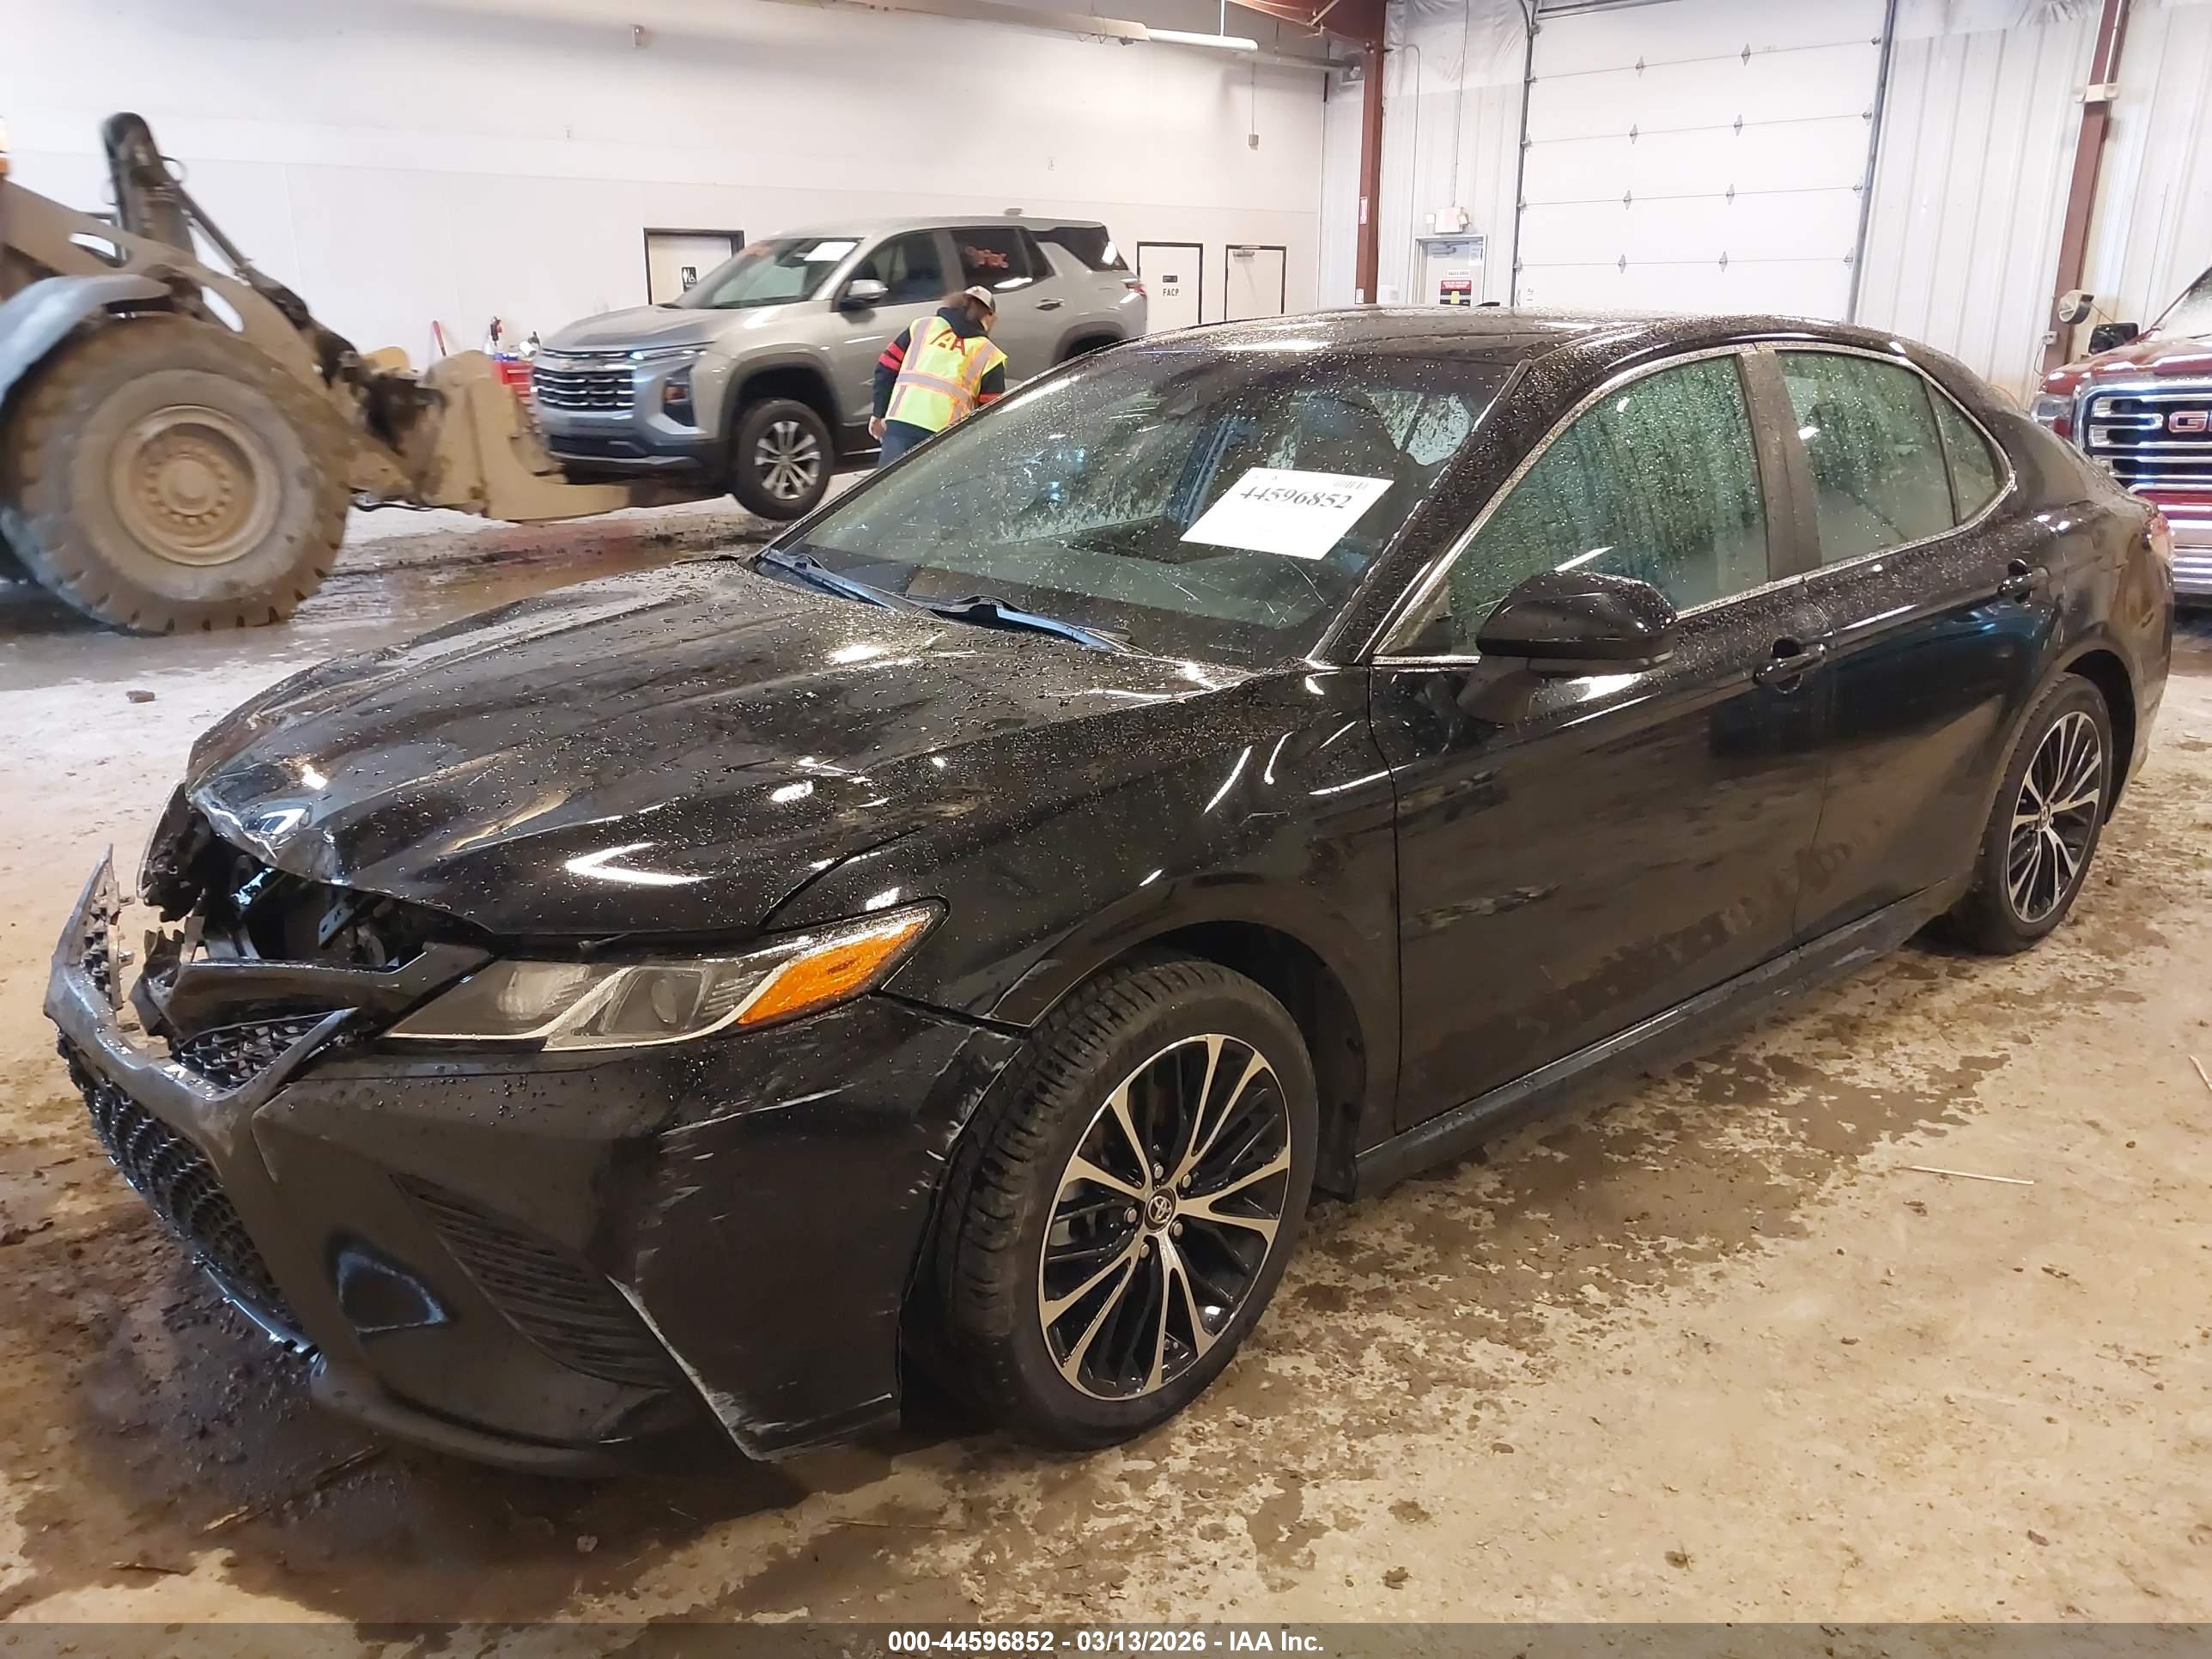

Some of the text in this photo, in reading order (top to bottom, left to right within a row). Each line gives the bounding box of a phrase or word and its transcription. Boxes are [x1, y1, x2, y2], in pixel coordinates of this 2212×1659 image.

[1163, 288, 1180, 296] FACP
[2168, 410, 2212, 434] G
[1239, 485, 1353, 509] 44596852
